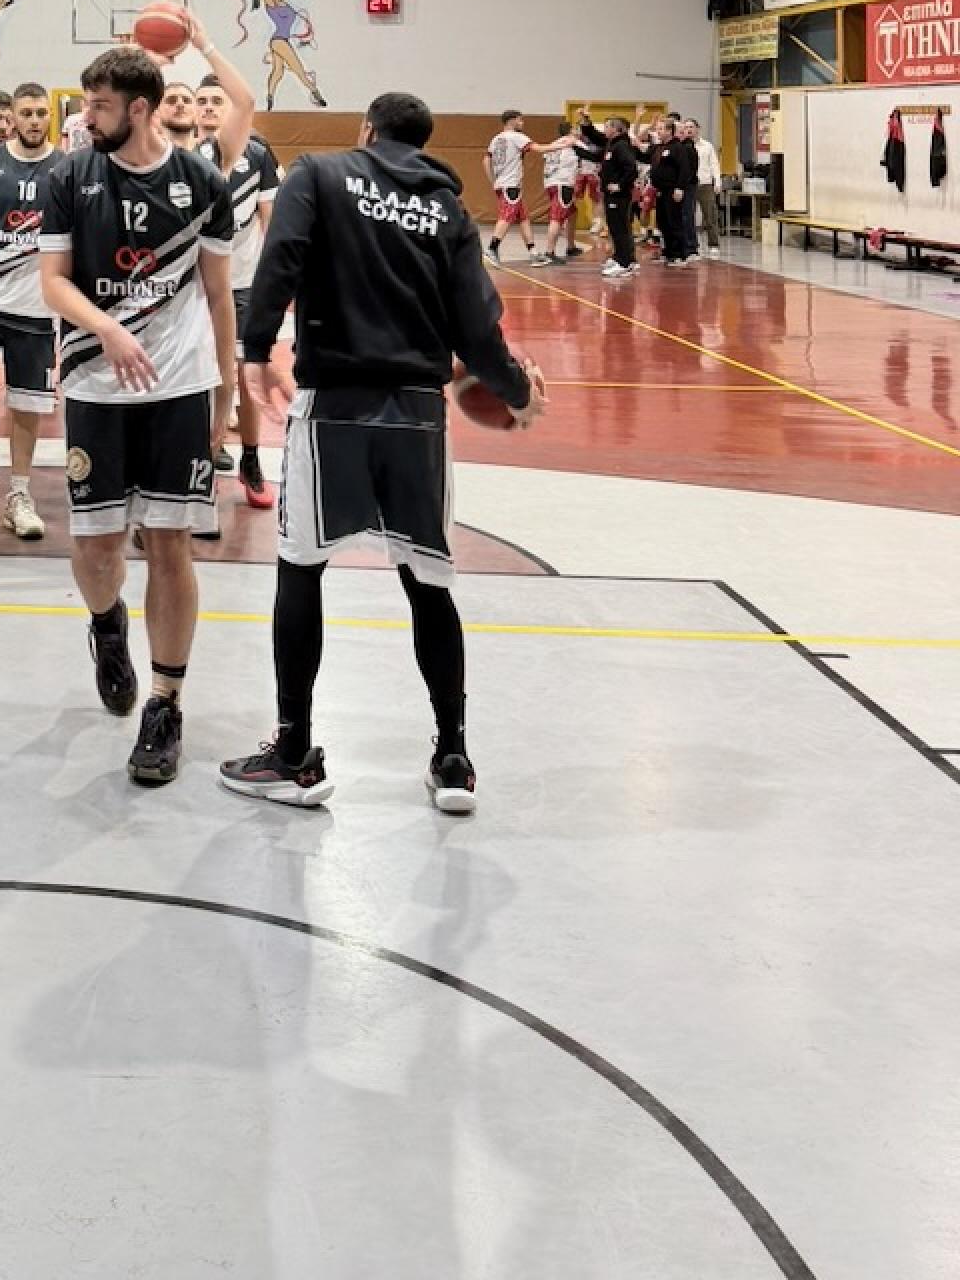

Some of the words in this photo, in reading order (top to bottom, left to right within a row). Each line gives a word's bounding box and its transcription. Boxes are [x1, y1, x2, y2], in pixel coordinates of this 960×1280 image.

[17, 181, 37, 201] 10
[121, 199, 149, 233] 12
[357, 198, 439, 237] COACH
[95, 277, 178, 303] OnlyNet
[190, 457, 214, 491] 12
